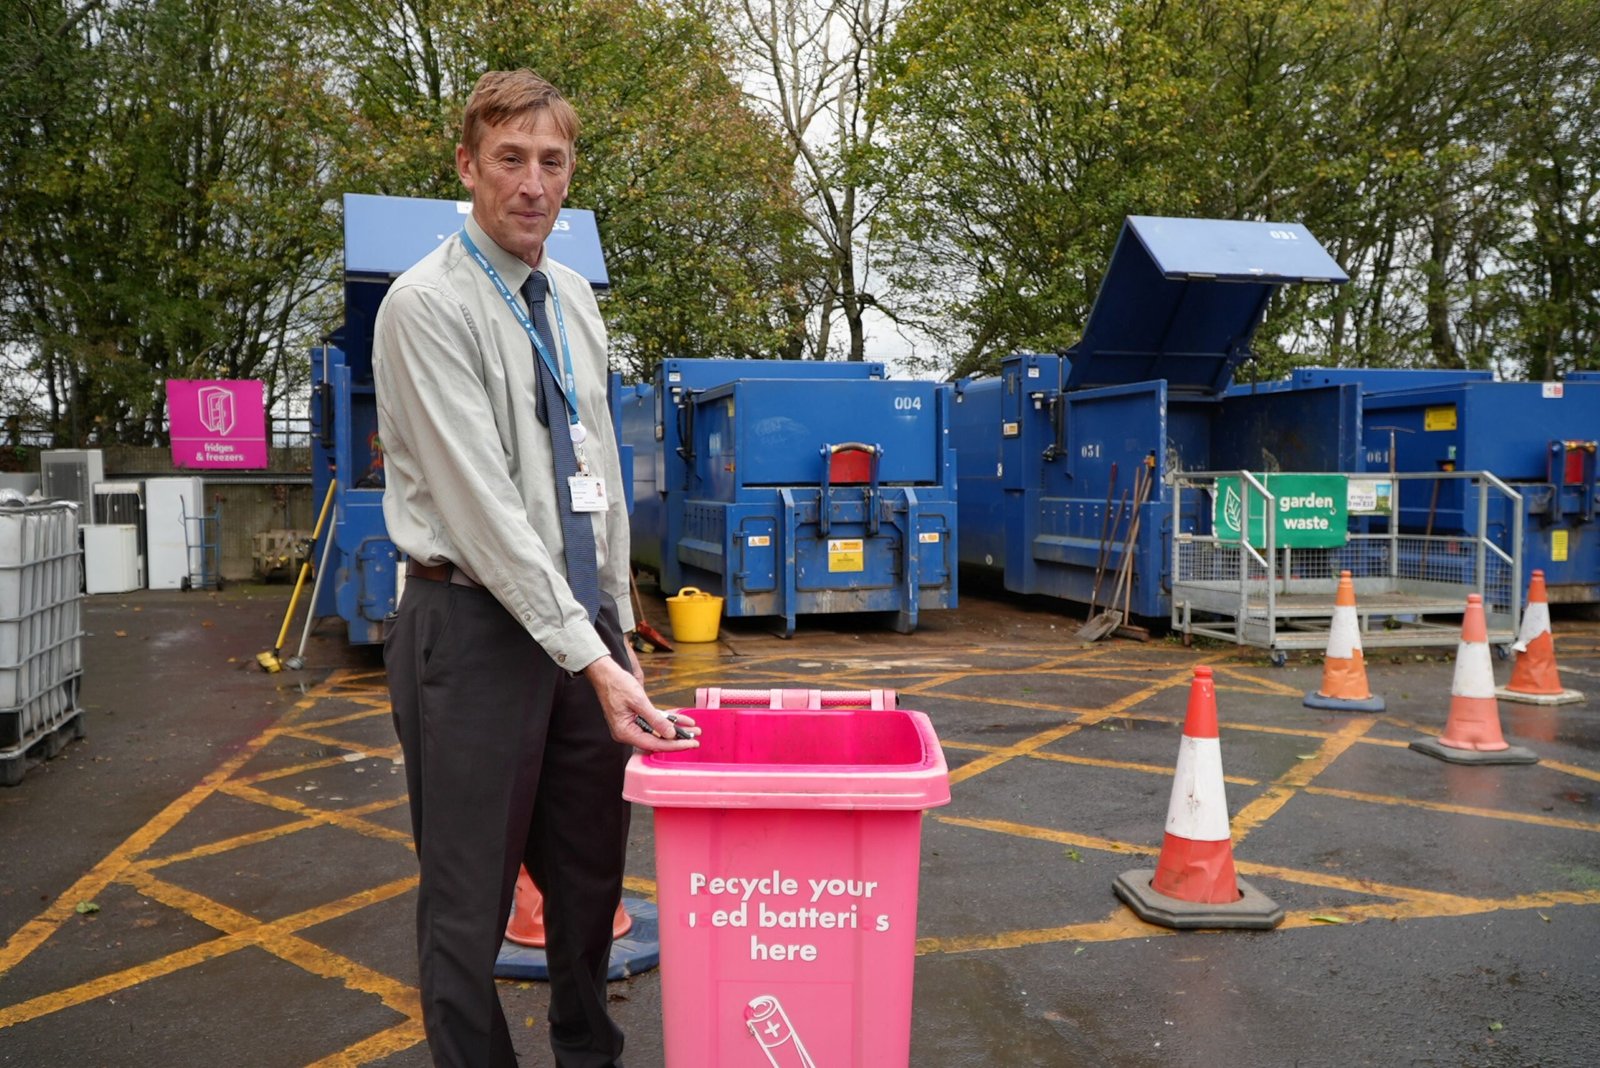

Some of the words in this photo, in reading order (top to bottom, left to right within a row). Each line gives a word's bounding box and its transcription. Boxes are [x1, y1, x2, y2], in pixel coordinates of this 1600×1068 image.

[894, 396, 922, 410] 004
[196, 452, 204, 461] &
[206, 452, 244, 461] freezers
[204, 443, 234, 454] fridges
[1280, 492, 1333, 512] garden
[1283, 516, 1329, 530] waste
[808, 878, 878, 903] your
[759, 902, 890, 932] batteris
[750, 935, 818, 961] here
